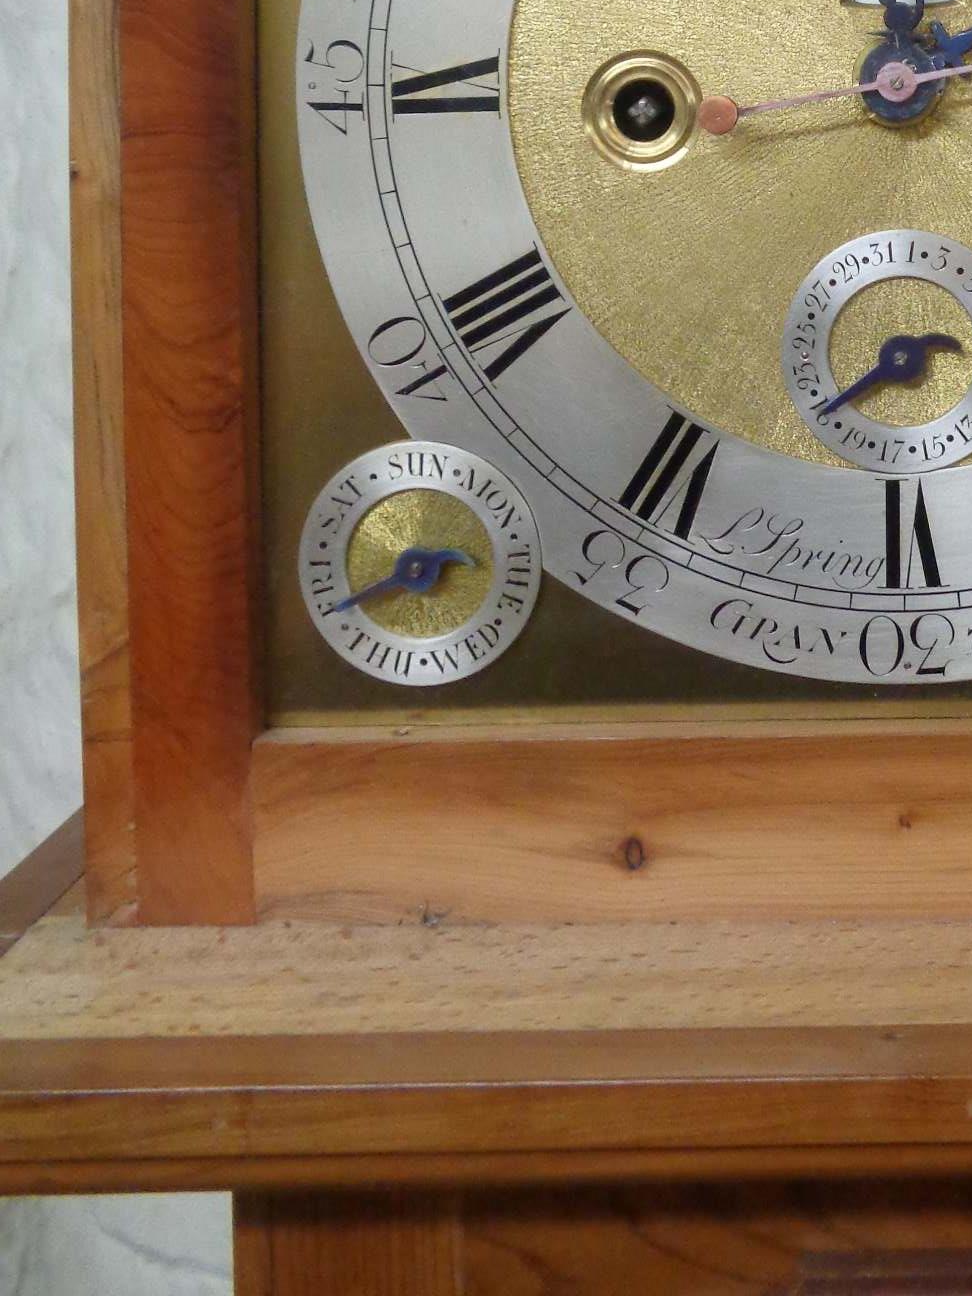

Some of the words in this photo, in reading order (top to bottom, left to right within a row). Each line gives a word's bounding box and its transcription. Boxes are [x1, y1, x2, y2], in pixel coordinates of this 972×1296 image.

[304, 39, 366, 136] 45
[832, 253, 861, 284] 29
[869, 240, 897, 266] 31
[904, 239, 916, 264] 1
[930, 245, 952, 271] 3
[803, 279, 833, 313] 27
[791, 321, 817, 351] 25
[366, 315, 457, 402] 40
[791, 362, 822, 392] 23
[839, 426, 867, 450] 19
[874, 438, 905, 464] 17
[920, 438, 947, 462] 15
[387, 452, 450, 481] SUN
[319, 475, 363, 535] SAT
[459, 468, 522, 529] MON
[875, 477, 951, 590] VI
[309, 559, 338, 618] FRI
[571, 528, 670, 617] 35
[345, 627, 416, 678] THU
[429, 623, 501, 674] WED
[858, 612, 955, 677] 30
